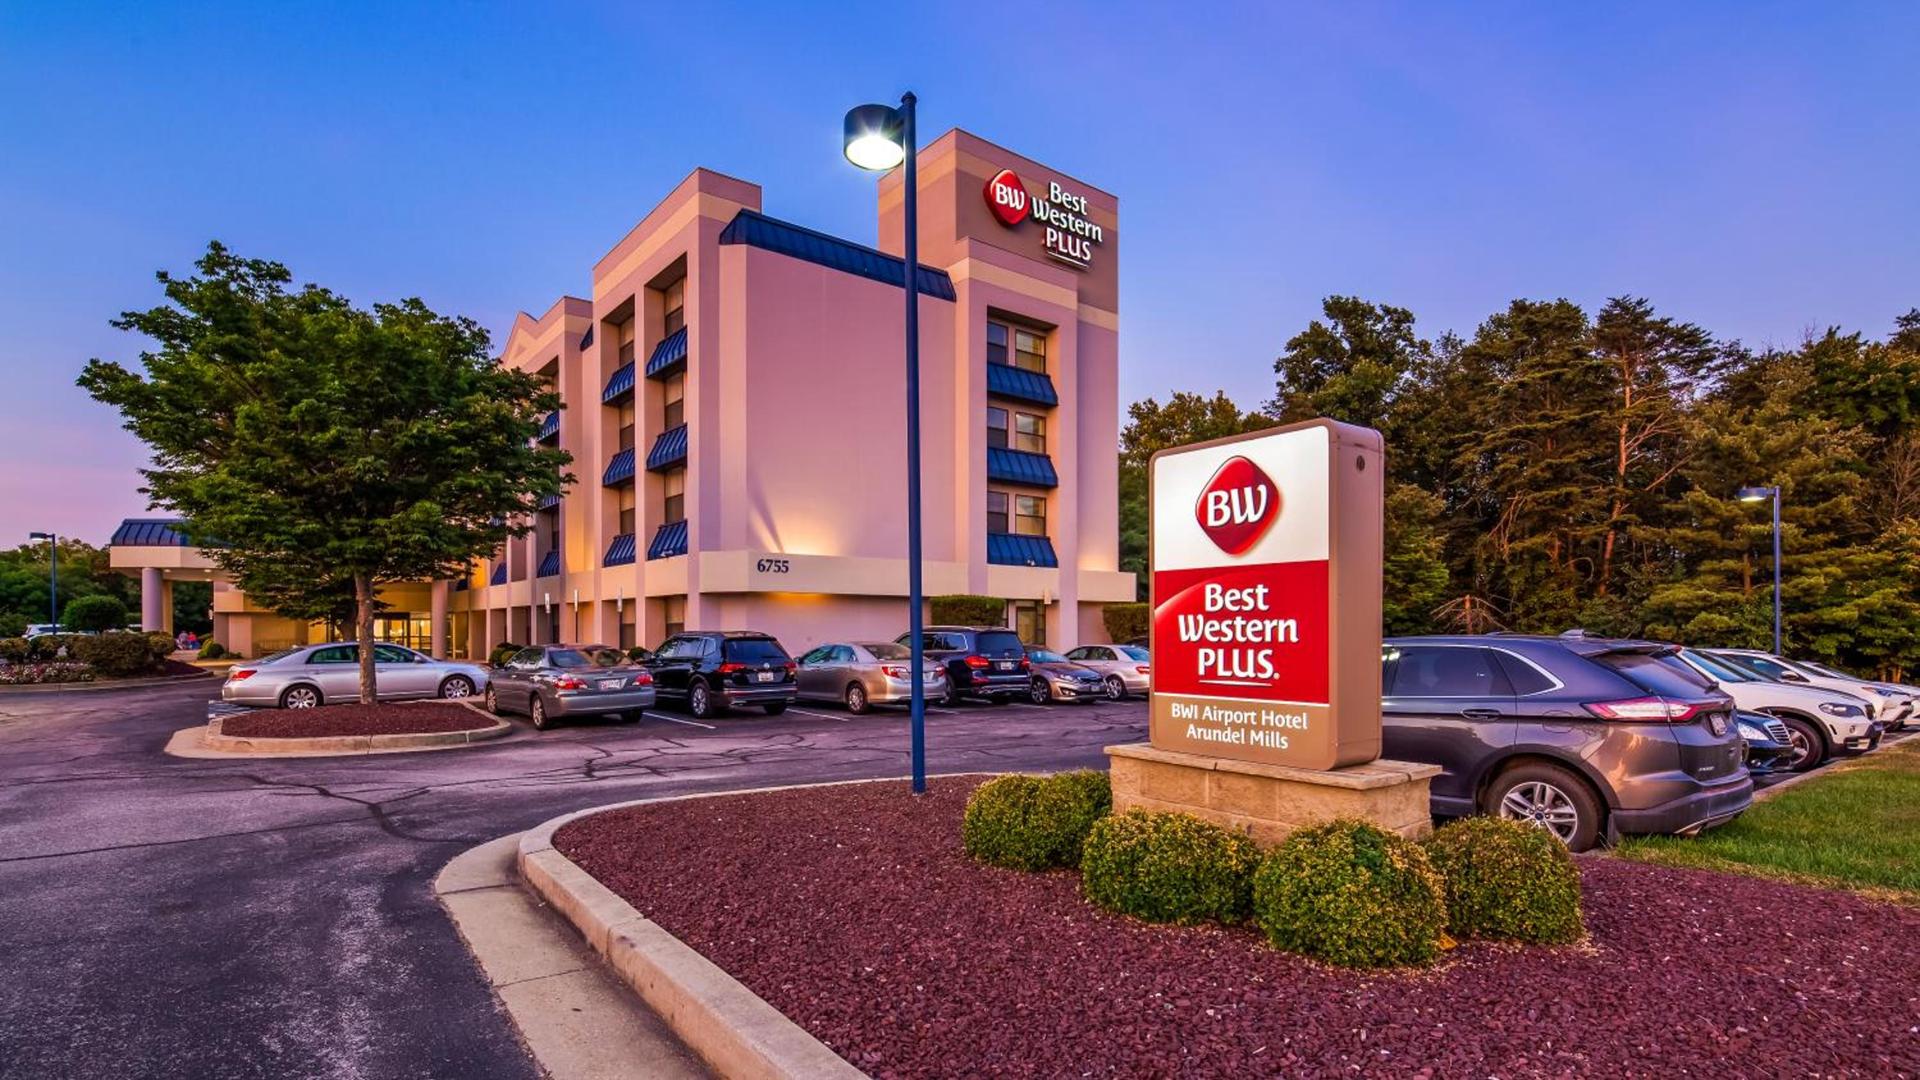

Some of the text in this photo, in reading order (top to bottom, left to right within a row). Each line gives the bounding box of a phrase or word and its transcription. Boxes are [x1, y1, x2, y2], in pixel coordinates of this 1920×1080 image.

[995, 183, 1025, 210] BW
[1050, 181, 1087, 215] Best
[1032, 197, 1102, 242] Western
[1046, 227, 1091, 261] PLUS
[1207, 484, 1267, 527] BW
[757, 558, 789, 573] 6755
[1204, 583, 1269, 612] Best
[1178, 614, 1299, 642] Western
[1171, 703, 1308, 729] BWI Airport Hotel
[1186, 724, 1288, 749] Arundel Mills
